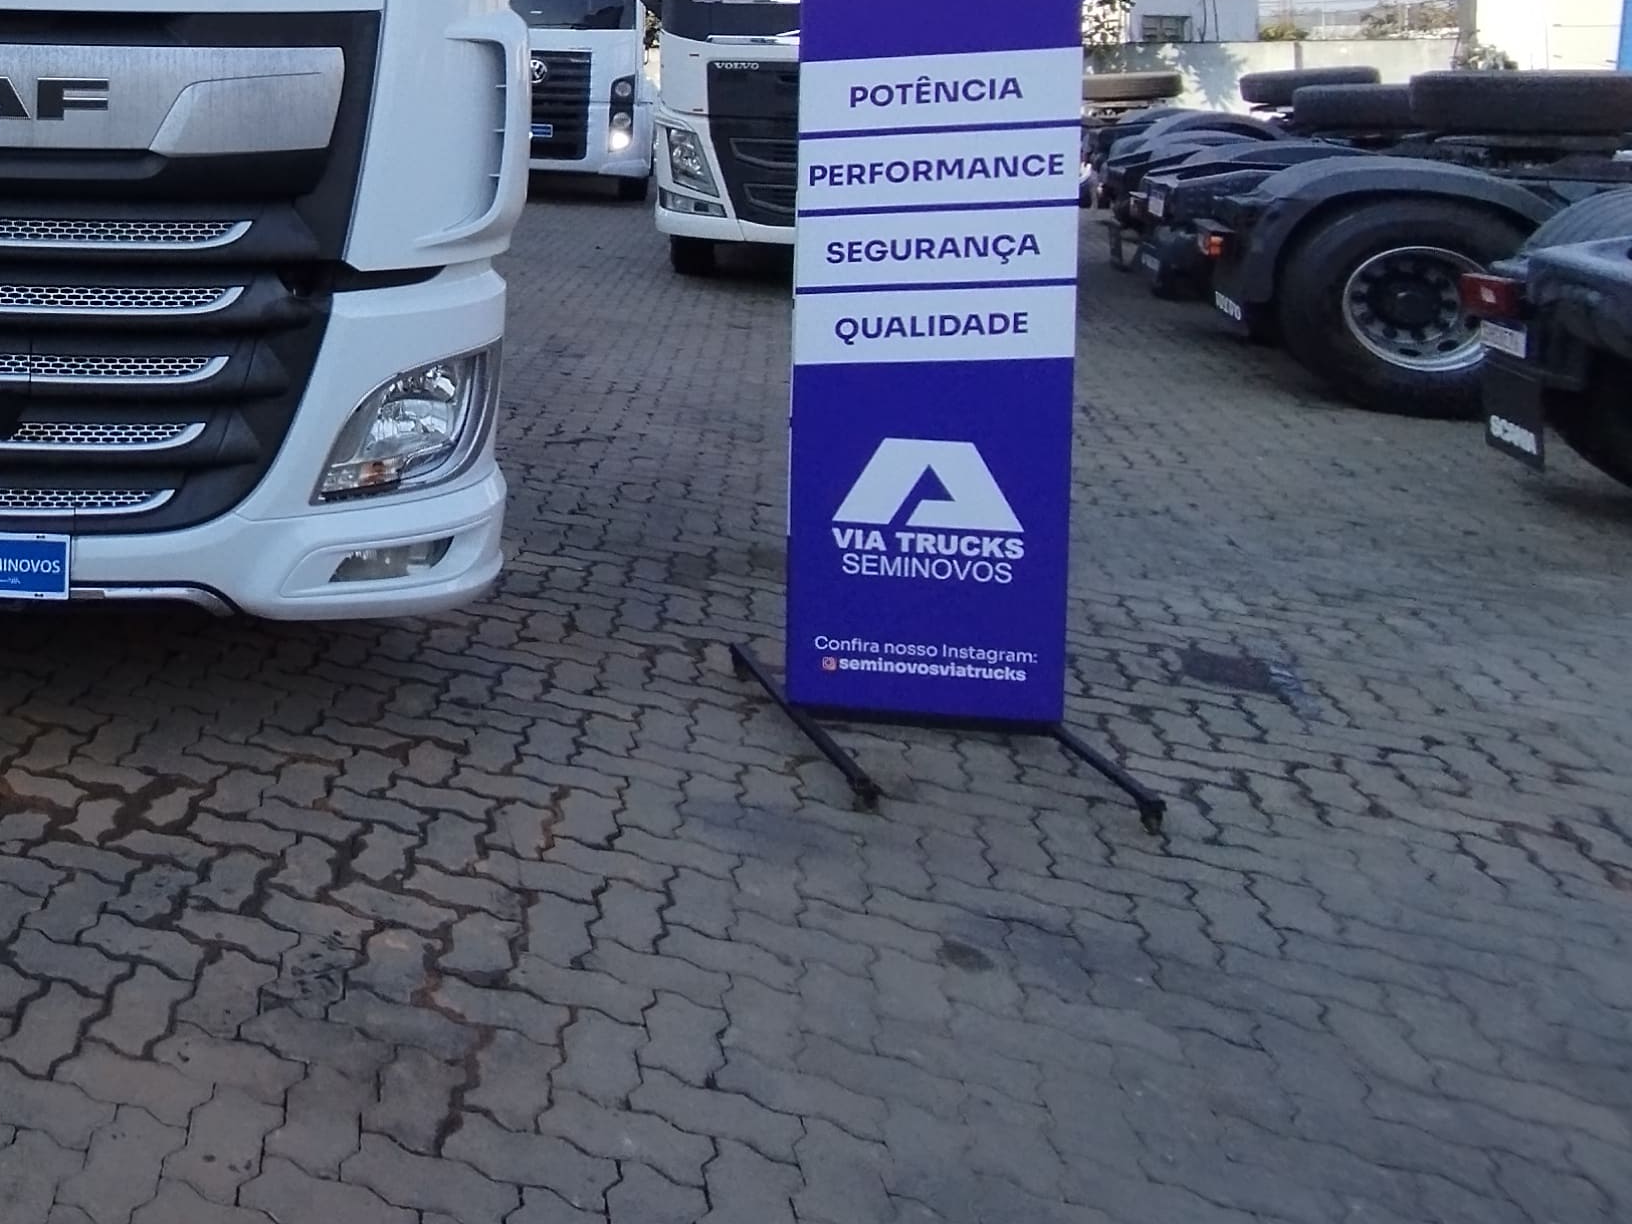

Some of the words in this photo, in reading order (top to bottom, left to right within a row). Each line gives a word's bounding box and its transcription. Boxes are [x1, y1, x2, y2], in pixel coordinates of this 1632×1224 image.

[714, 62, 759, 70] VOLVO
[850, 76, 1023, 108] POTÊNCIA
[809, 153, 1065, 187] PERFORMANCE
[826, 233, 1041, 265] SEGURANÇA
[835, 312, 1029, 345] QUALIDADE
[832, 527, 887, 552] VIA
[895, 531, 1025, 560] TRUCKS
[842, 553, 1013, 583] SEMINOVOS
[814, 636, 880, 654] Confira
[884, 642, 938, 658] nosso
[942, 644, 1039, 664] Instagram:
[839, 656, 1027, 682] seminovosviatrucks
